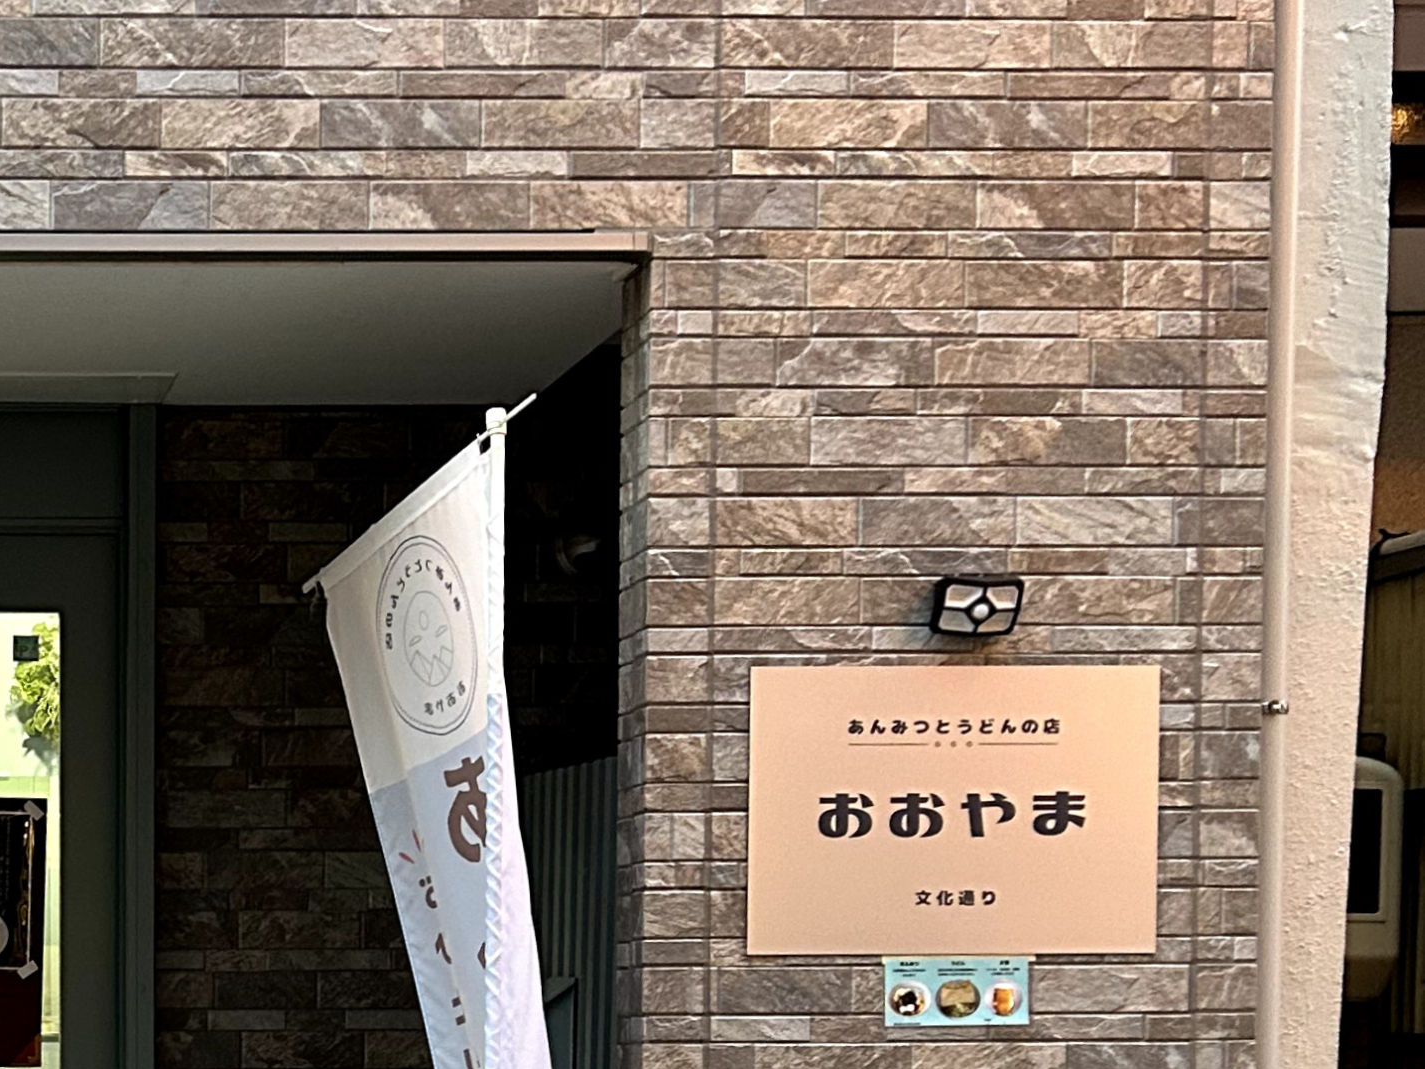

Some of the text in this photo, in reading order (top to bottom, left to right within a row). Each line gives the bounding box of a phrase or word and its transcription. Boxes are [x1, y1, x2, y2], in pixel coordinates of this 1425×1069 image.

[847, 717, 1062, 736] あんみつとうどんの店
[817, 790, 1089, 839] おおやま
[915, 889, 998, 906] 文化通り
